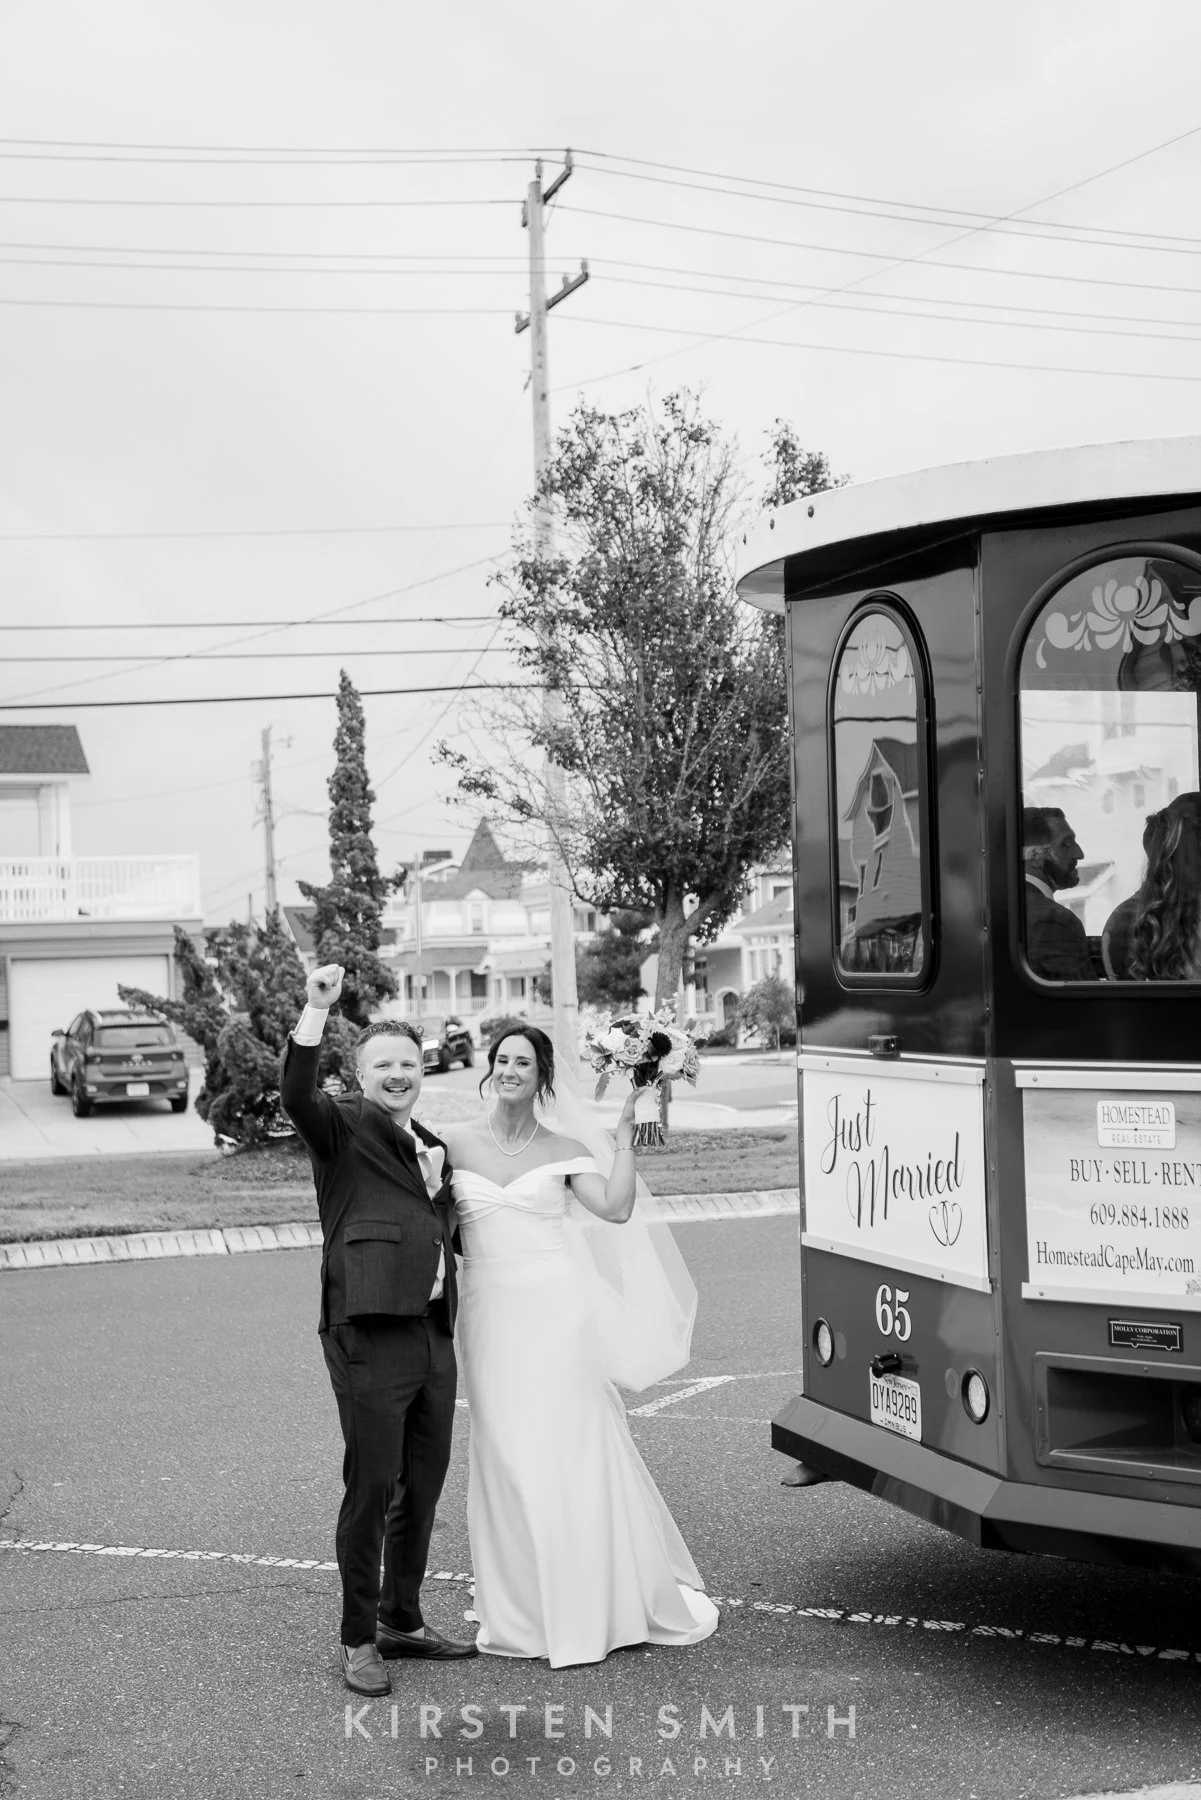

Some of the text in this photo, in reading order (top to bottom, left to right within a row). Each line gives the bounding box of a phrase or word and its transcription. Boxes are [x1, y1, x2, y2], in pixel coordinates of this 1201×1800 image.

[821, 1088, 876, 1174] Just
[1101, 1106, 1171, 1125] HOMESTEAD
[1111, 1133, 1162, 1145] REAL ESTATE
[847, 1132, 964, 1228] Married
[1090, 1203, 1189, 1230] 609.884.1888
[1036, 1241, 1195, 1277] HomesteadCapeMay.com
[875, 1284, 912, 1341] 65
[1114, 1325, 1177, 1336] MOLLY CORPORATION
